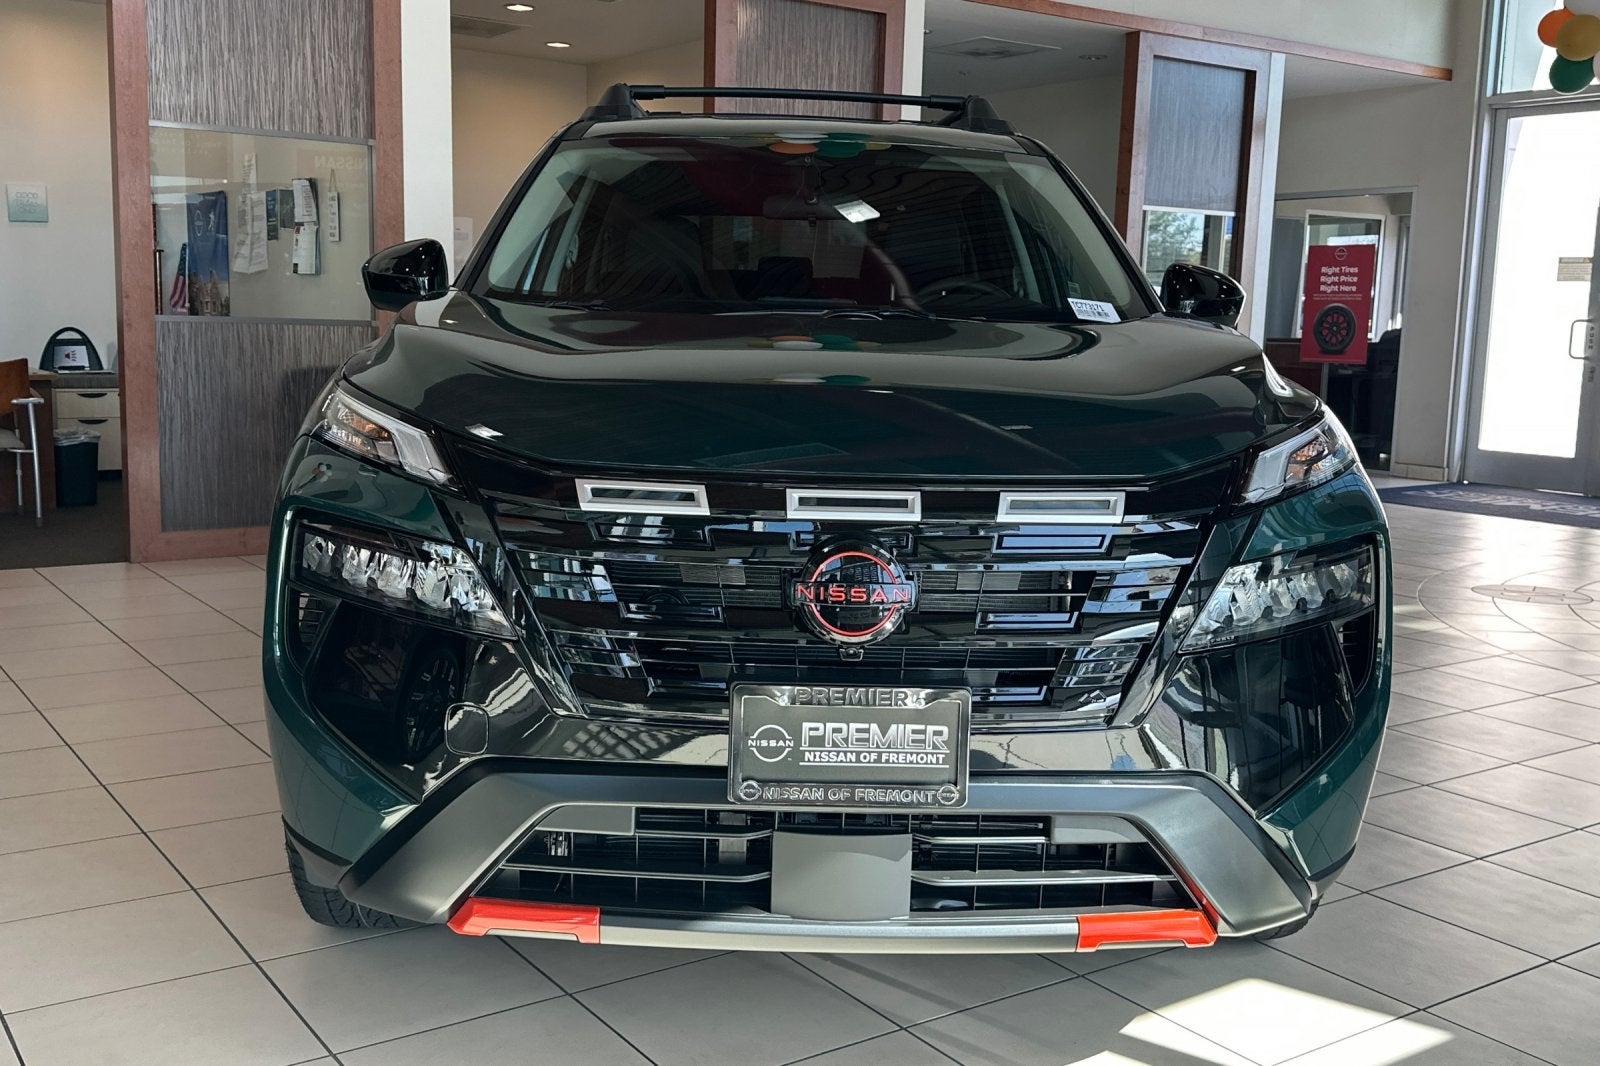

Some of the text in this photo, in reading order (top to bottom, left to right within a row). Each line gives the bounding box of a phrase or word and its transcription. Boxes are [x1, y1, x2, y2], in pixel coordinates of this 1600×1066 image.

[1321, 266, 1340, 274] Right
[1320, 275, 1339, 283] Right
[1320, 284, 1338, 293] Right
[796, 583, 912, 602] NISSAN
[794, 687, 909, 707] PREMIER
[801, 722, 949, 750] PREMIER
[748, 739, 794, 748] NISSAN
[804, 752, 946, 764] NISSAN OF FREMONT
[763, 786, 936, 803] NISSAN OF FREMONT
